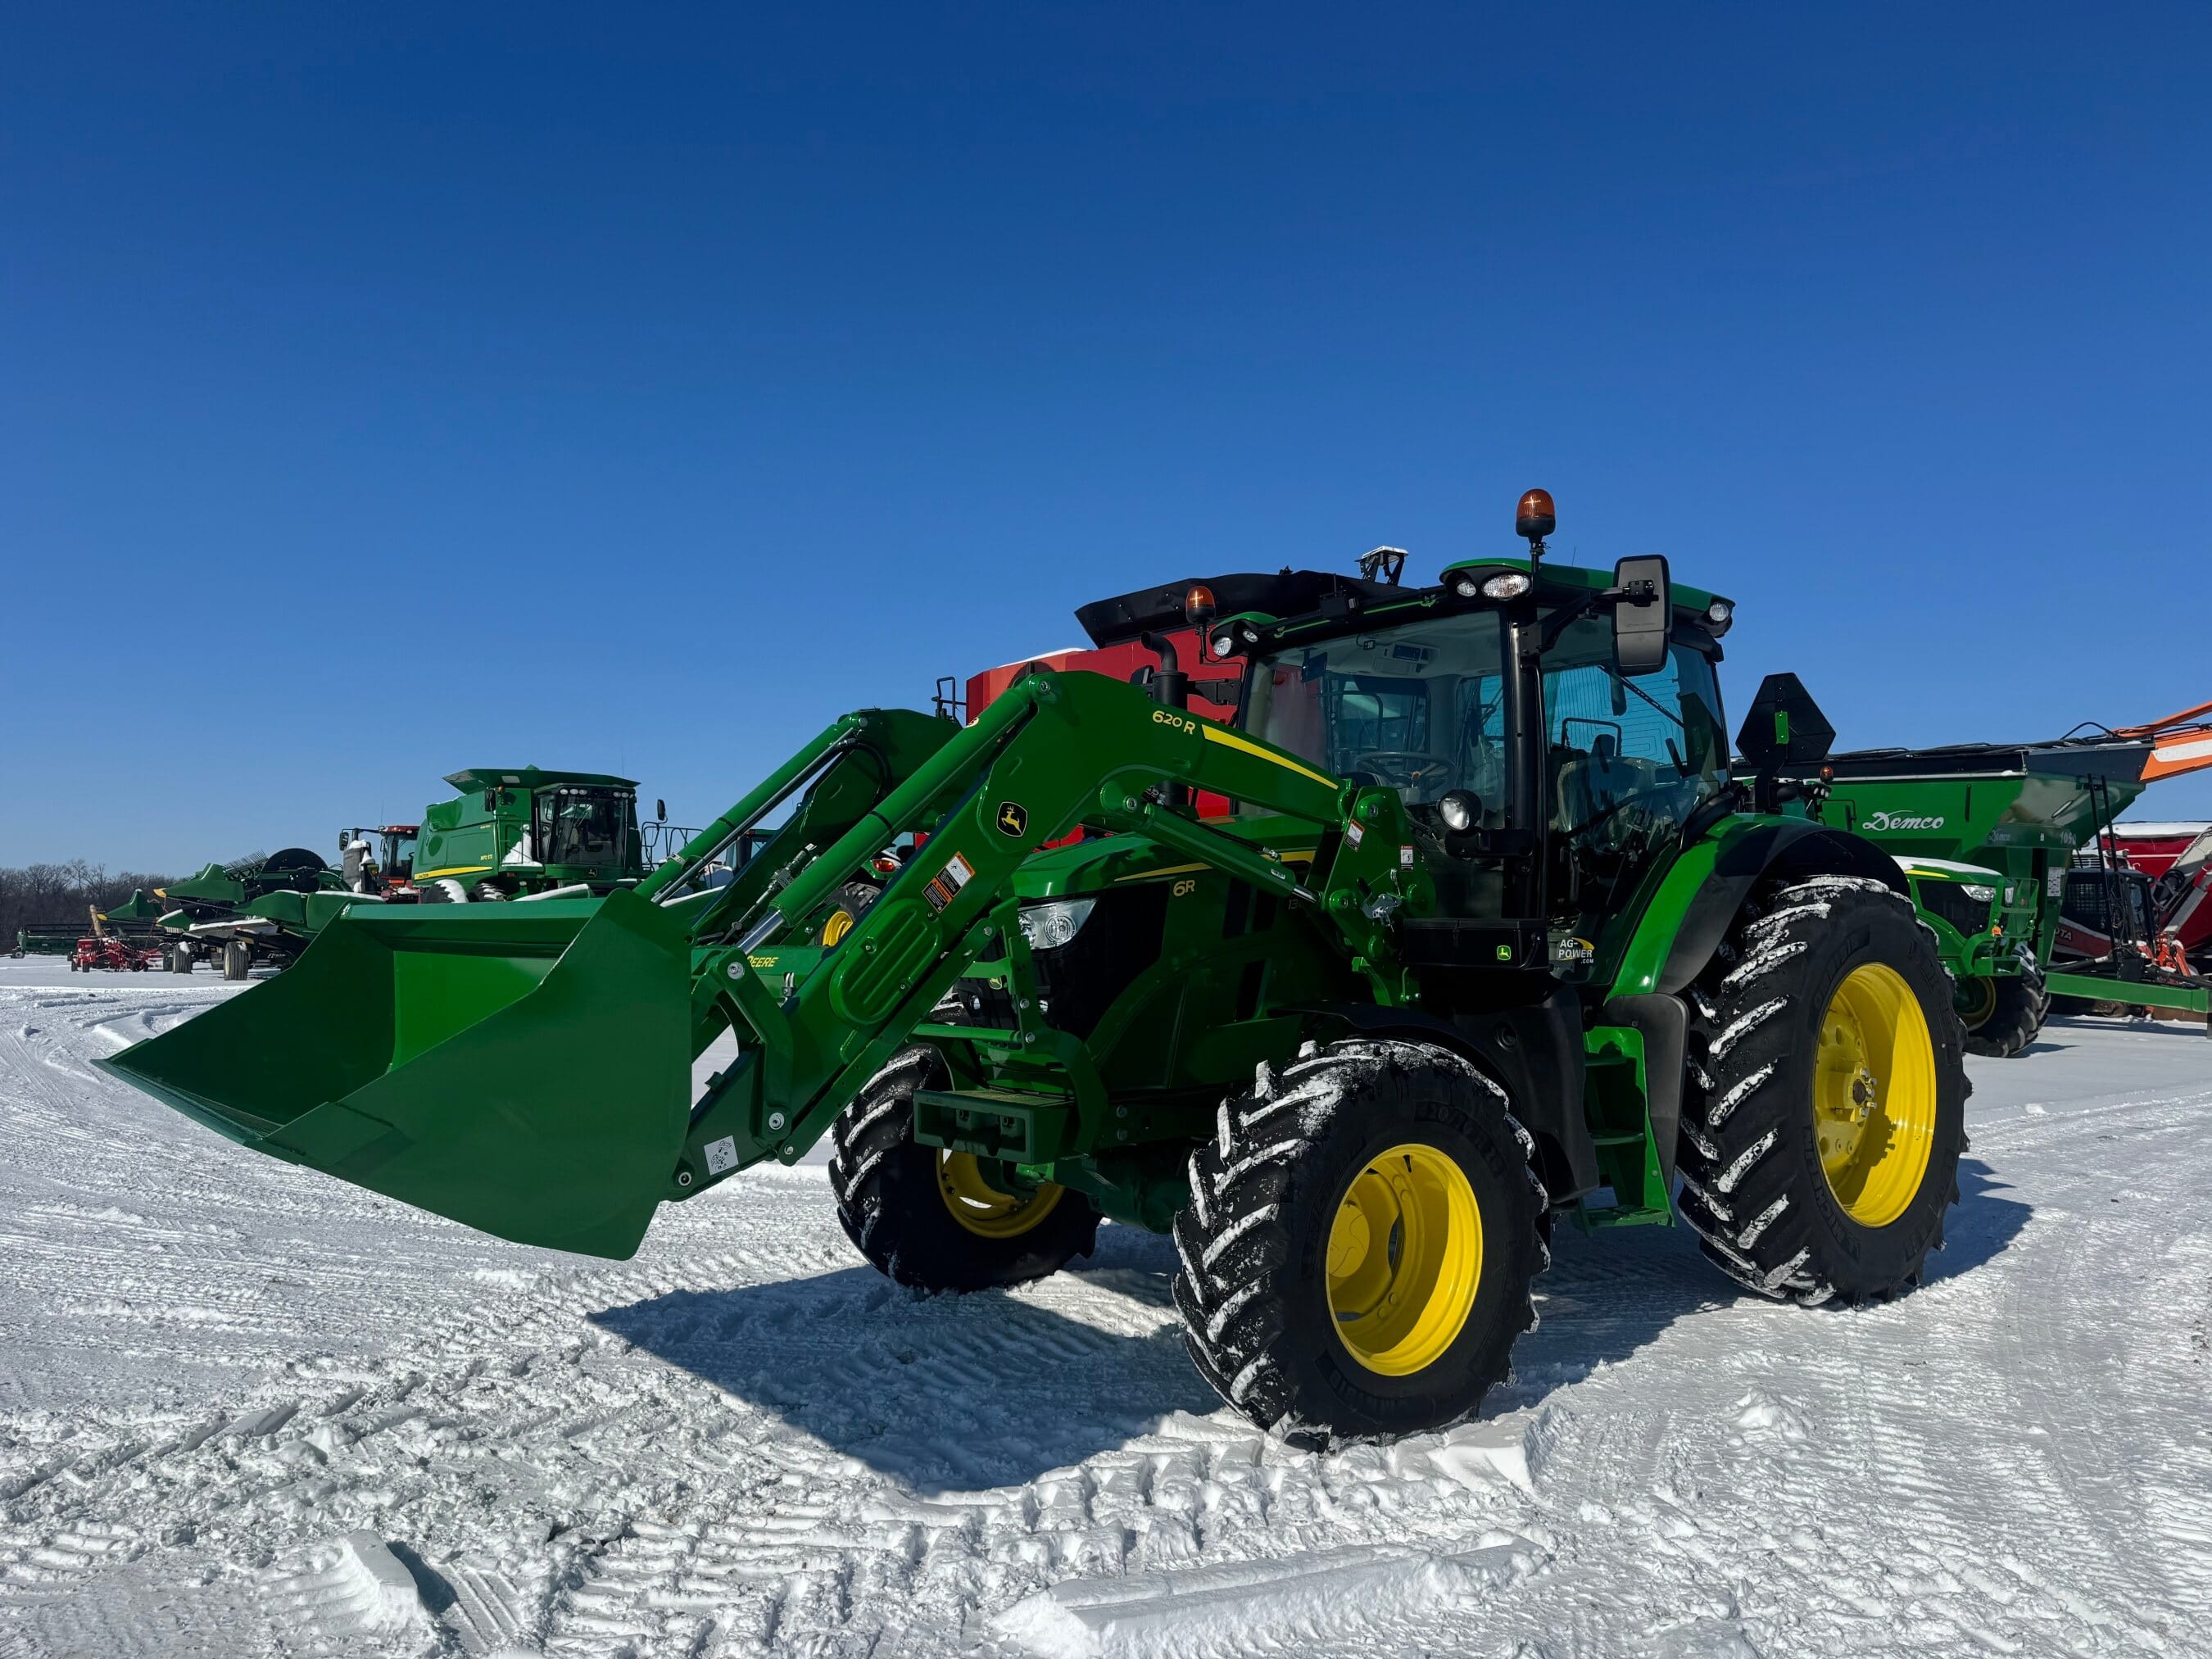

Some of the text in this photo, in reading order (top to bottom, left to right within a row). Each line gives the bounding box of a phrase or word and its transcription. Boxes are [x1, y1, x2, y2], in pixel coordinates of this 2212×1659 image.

[1862, 809, 1944, 831] Demco
[1173, 880, 1195, 897] 6R
[1559, 939, 1579, 948] AG-
[1558, 949, 1593, 959] POWER
